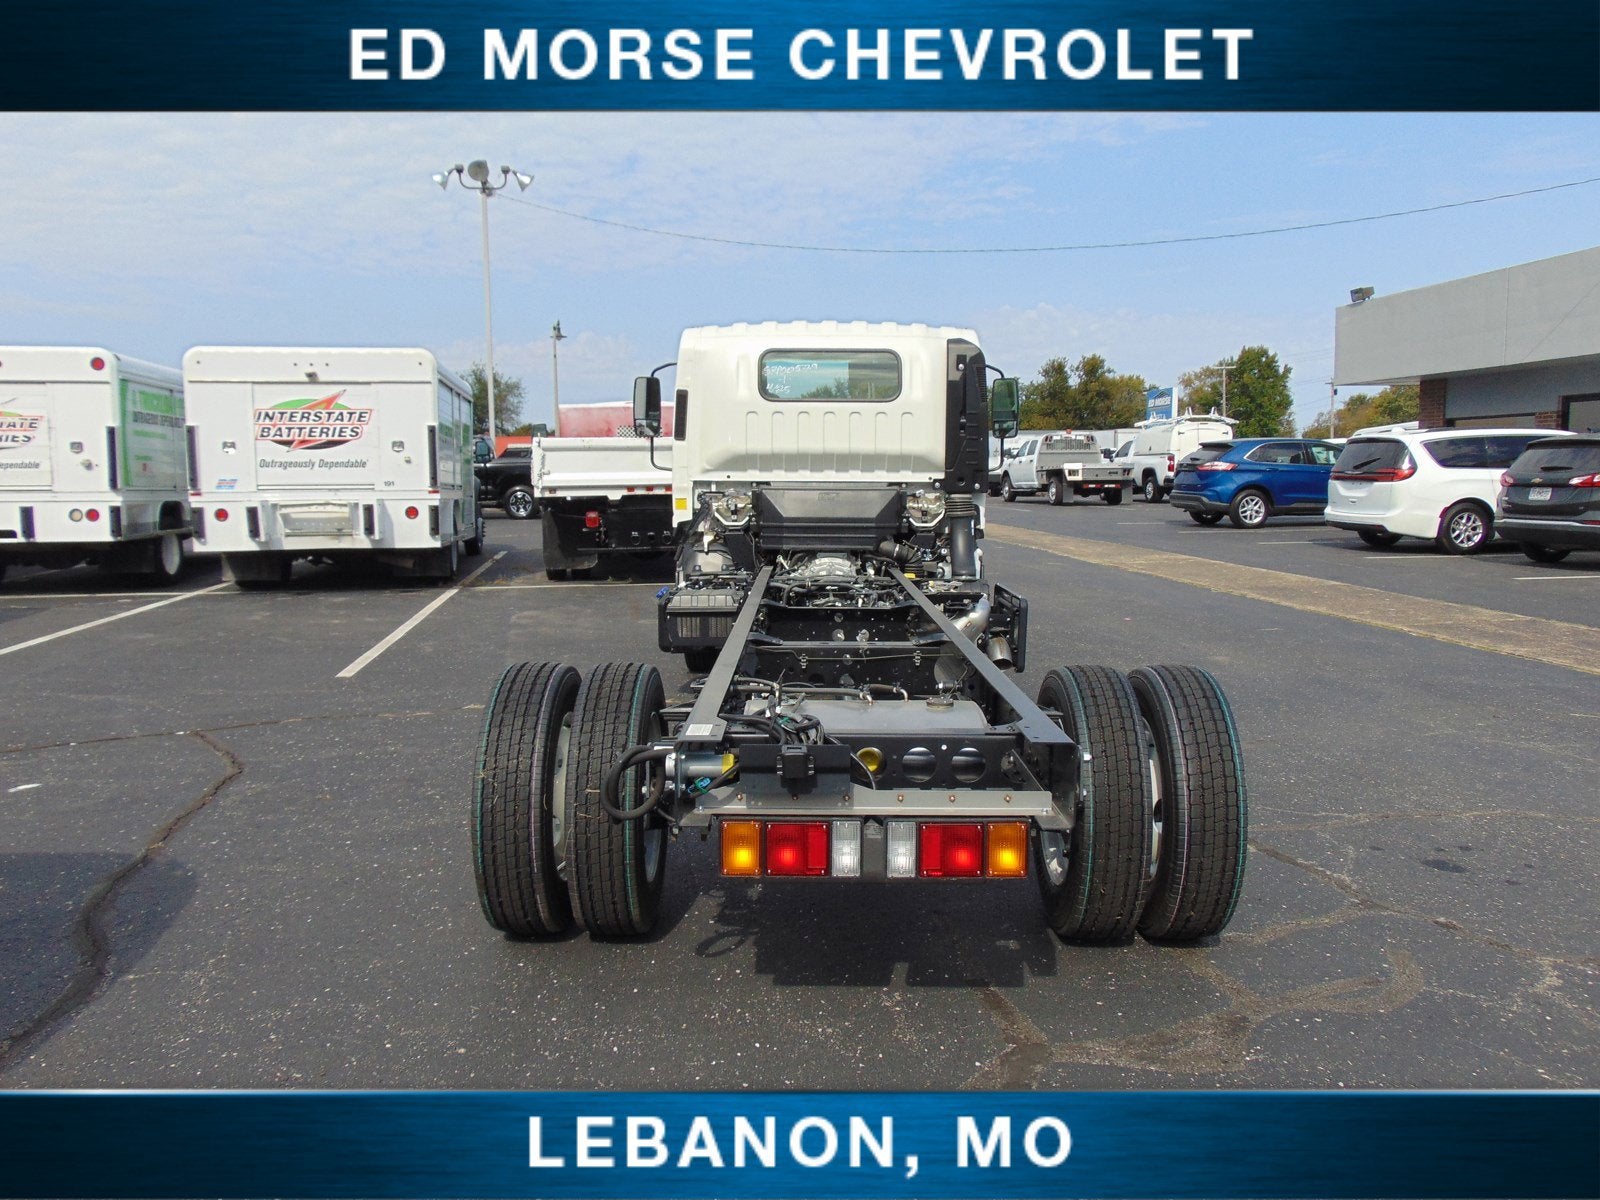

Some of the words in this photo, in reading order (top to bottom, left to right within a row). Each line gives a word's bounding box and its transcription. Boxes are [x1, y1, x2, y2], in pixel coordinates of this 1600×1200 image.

[256, 411, 368, 422] INTERSTATE
[259, 426, 360, 438] BATTERIES
[259, 458, 315, 470] Outrageously
[318, 459, 367, 469] Dependable
